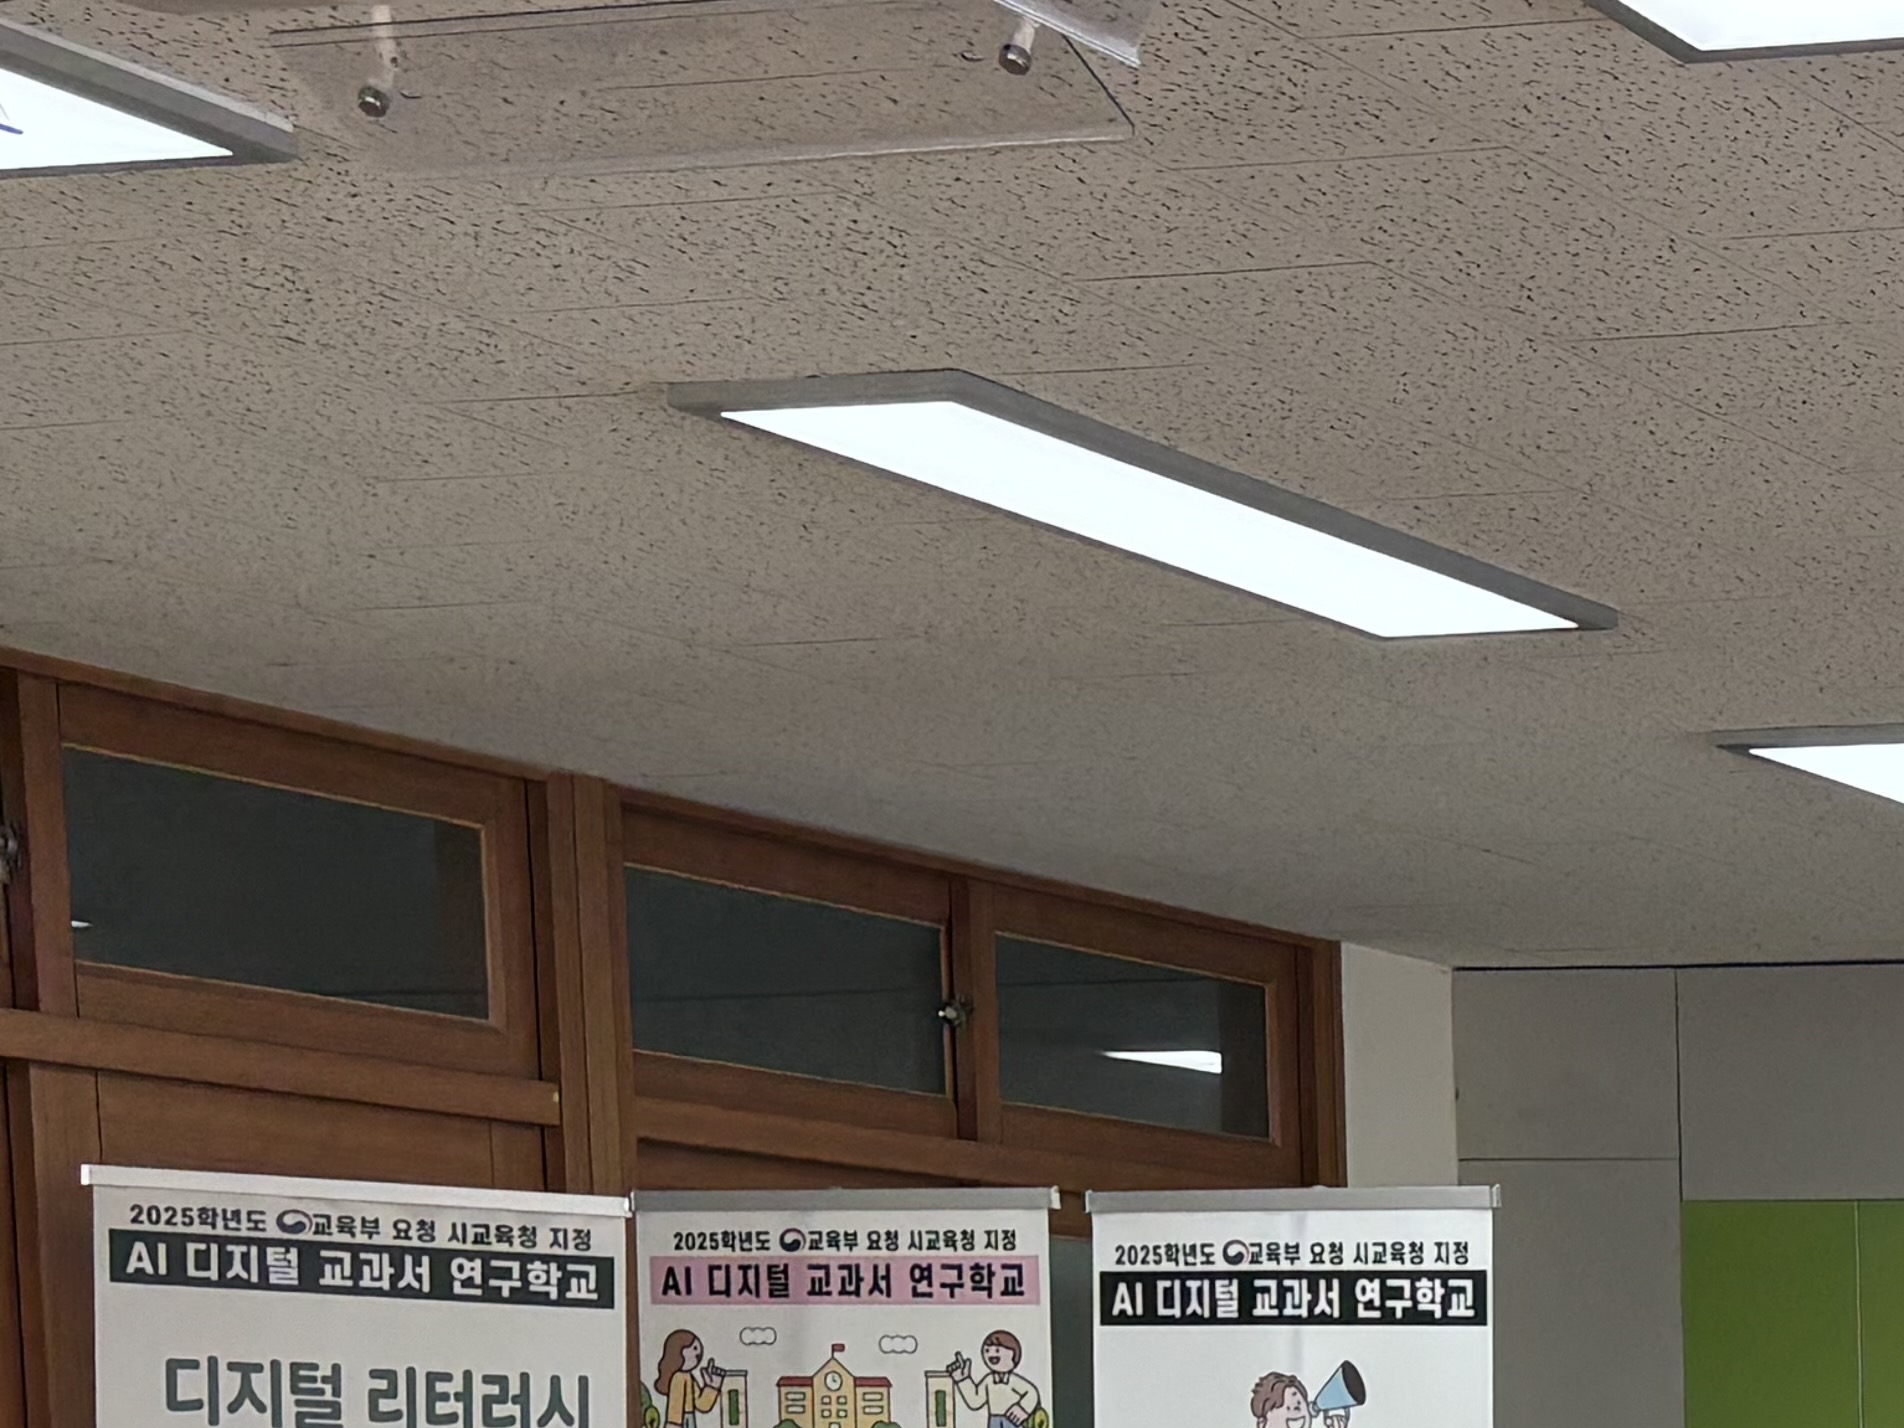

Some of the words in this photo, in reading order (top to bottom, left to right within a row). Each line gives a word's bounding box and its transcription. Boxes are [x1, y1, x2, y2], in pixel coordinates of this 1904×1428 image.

[129, 1204, 267, 1232] 2025학년도
[312, 1214, 380, 1240] 교육부
[392, 1219, 436, 1243] 요청
[447, 1223, 538, 1248] 시교육청
[549, 1227, 591, 1252] 지정
[673, 1229, 771, 1252] 2025학년도
[807, 1229, 859, 1251] 교육부
[867, 1229, 900, 1251] 요청
[907, 1229, 975, 1252] 시교육청
[984, 1229, 1017, 1251] 지정
[126, 1244, 167, 1276] AI
[186, 1243, 299, 1286] 디지털
[319, 1249, 431, 1292] 교과서
[449, 1255, 599, 1302] 연구학교
[1114, 1242, 1216, 1265] 2025학년도
[1249, 1242, 1300, 1265] 교육부
[1310, 1242, 1343, 1264] 요청
[1353, 1242, 1425, 1264] 시교육청
[1434, 1242, 1469, 1264] 지정
[661, 1265, 693, 1297] AI
[708, 1263, 791, 1298] 디지털
[806, 1263, 892, 1298] 교과서
[908, 1263, 1025, 1298] 연구학교
[1111, 1281, 1143, 1317] AI
[1157, 1278, 1240, 1318] 디지털
[1252, 1278, 1340, 1318] 교과서
[1355, 1277, 1476, 1317] 연구학교
